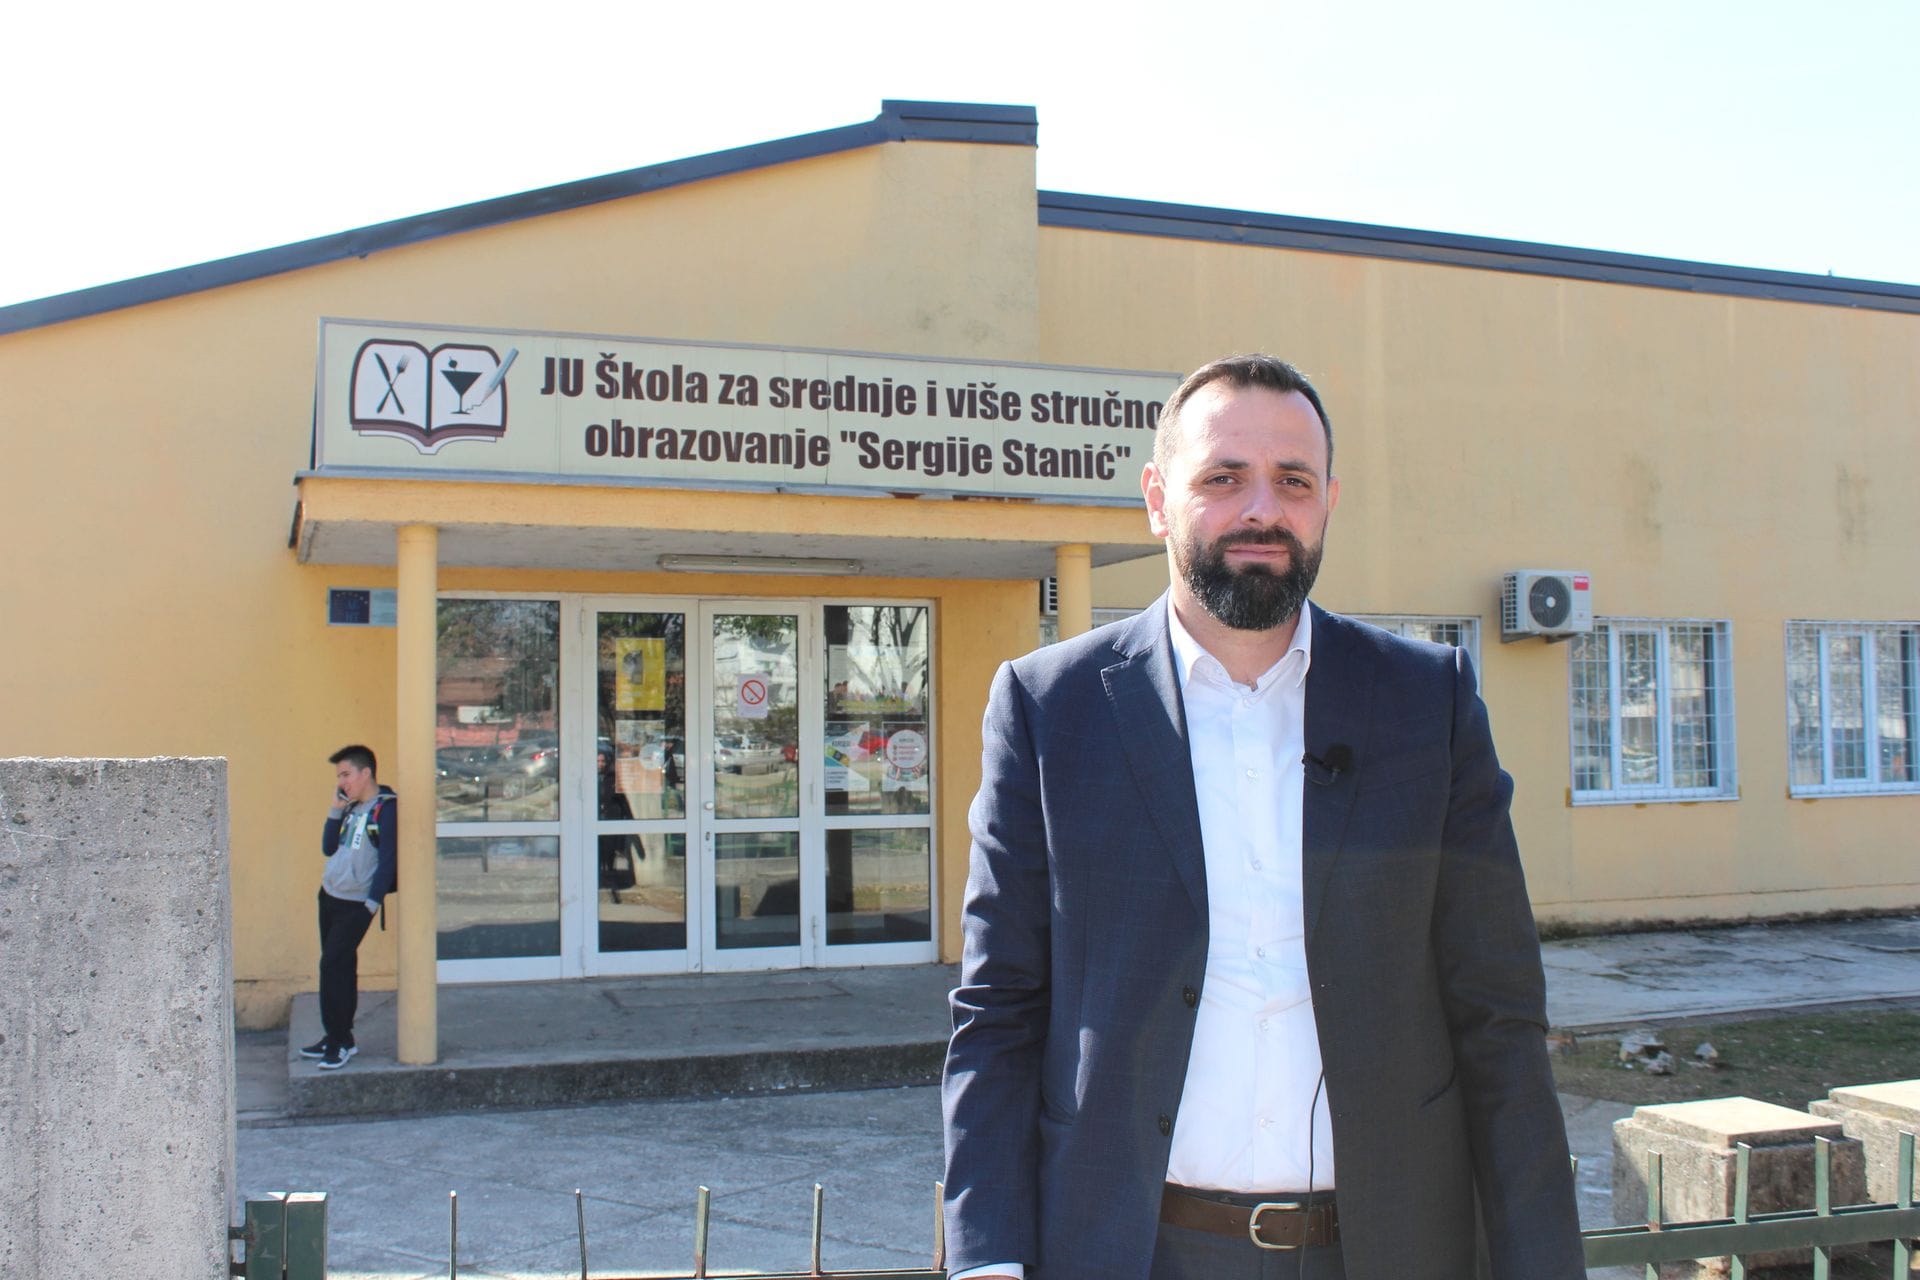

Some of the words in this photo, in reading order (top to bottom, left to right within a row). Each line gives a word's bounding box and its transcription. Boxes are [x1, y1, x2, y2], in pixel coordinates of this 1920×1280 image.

[541, 356, 584, 398] JU
[595, 352, 708, 404] Škola
[717, 373, 759, 408] za
[768, 376, 917, 418] srednje
[926, 380, 937, 417] i
[945, 381, 1022, 422] više
[1030, 390, 1164, 430] stručno
[584, 418, 831, 469] obrazovanje
[840, 430, 993, 477] "Sergije
[1002, 438, 1131, 481] Stanić"
